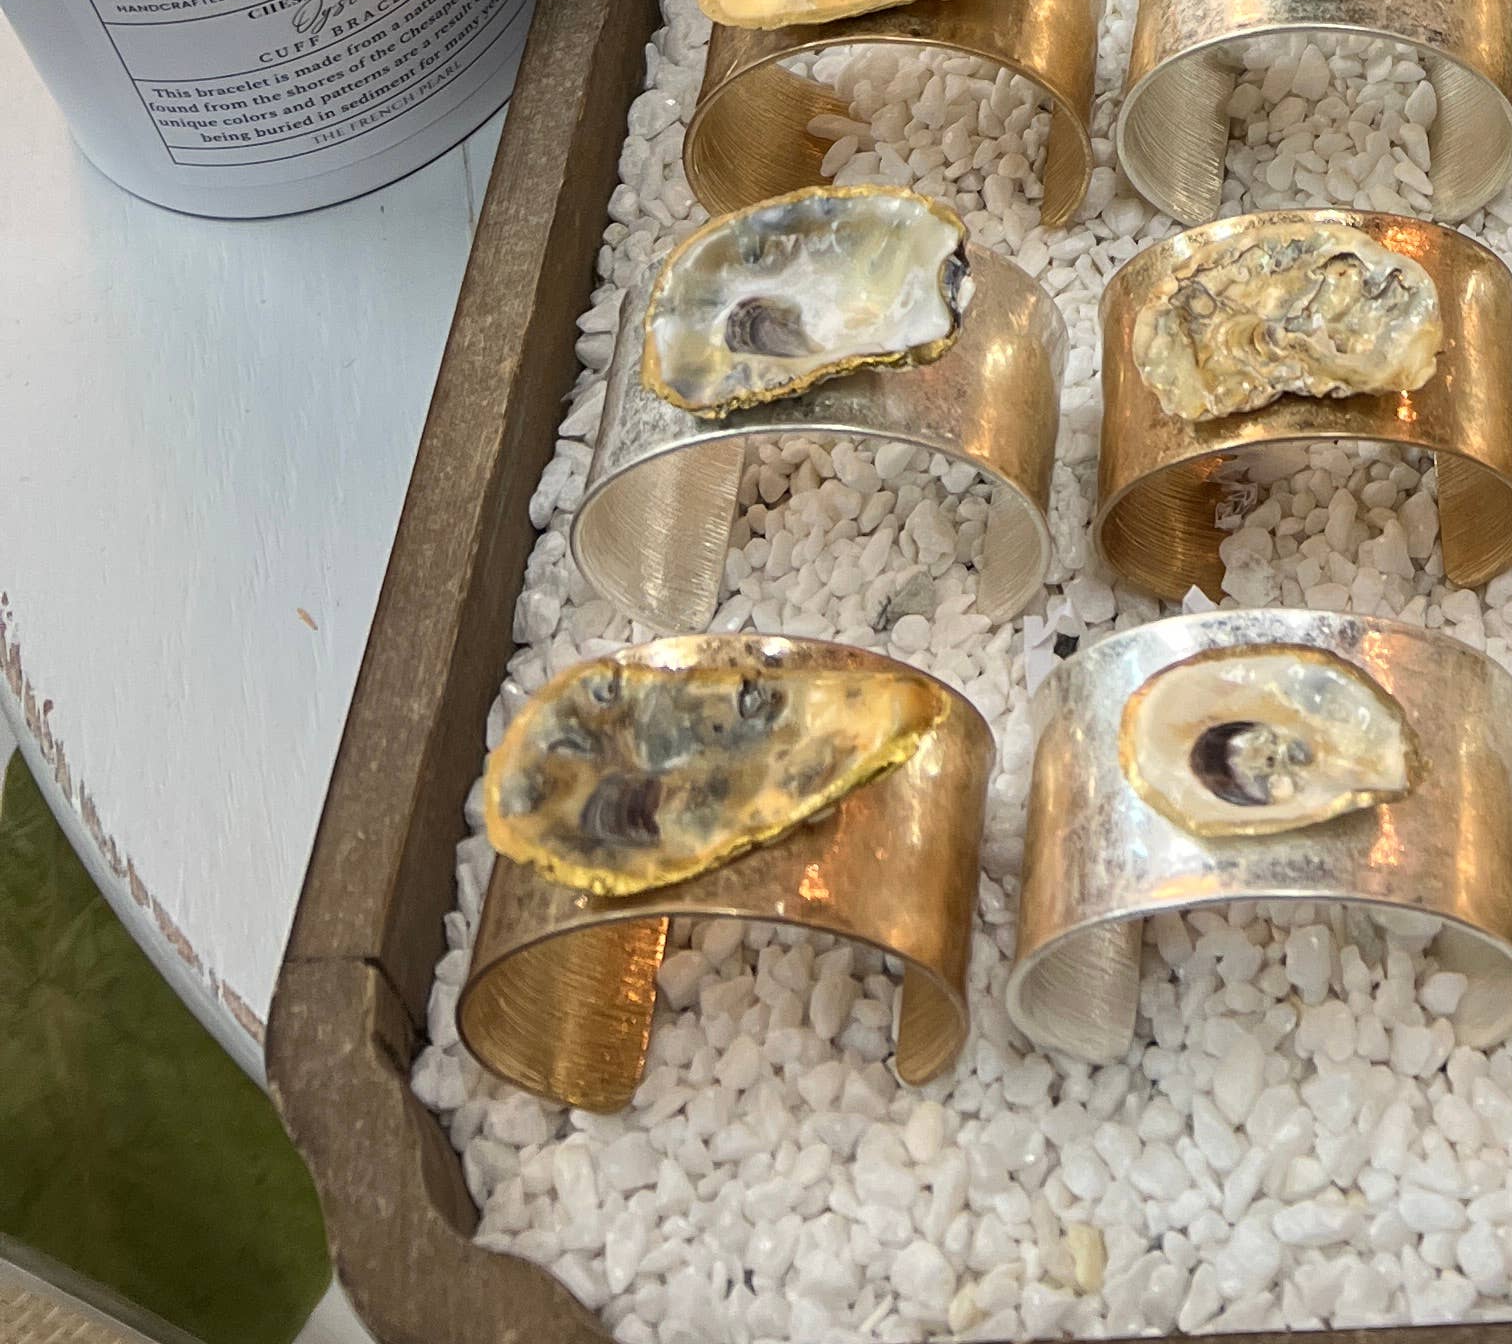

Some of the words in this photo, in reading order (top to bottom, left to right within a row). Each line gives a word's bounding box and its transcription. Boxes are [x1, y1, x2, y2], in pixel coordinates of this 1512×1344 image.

[258, 34, 321, 63] CUFF
[311, 129, 345, 144] THE
[350, 93, 415, 131] FRENCH
[419, 61, 461, 95] PEARL
